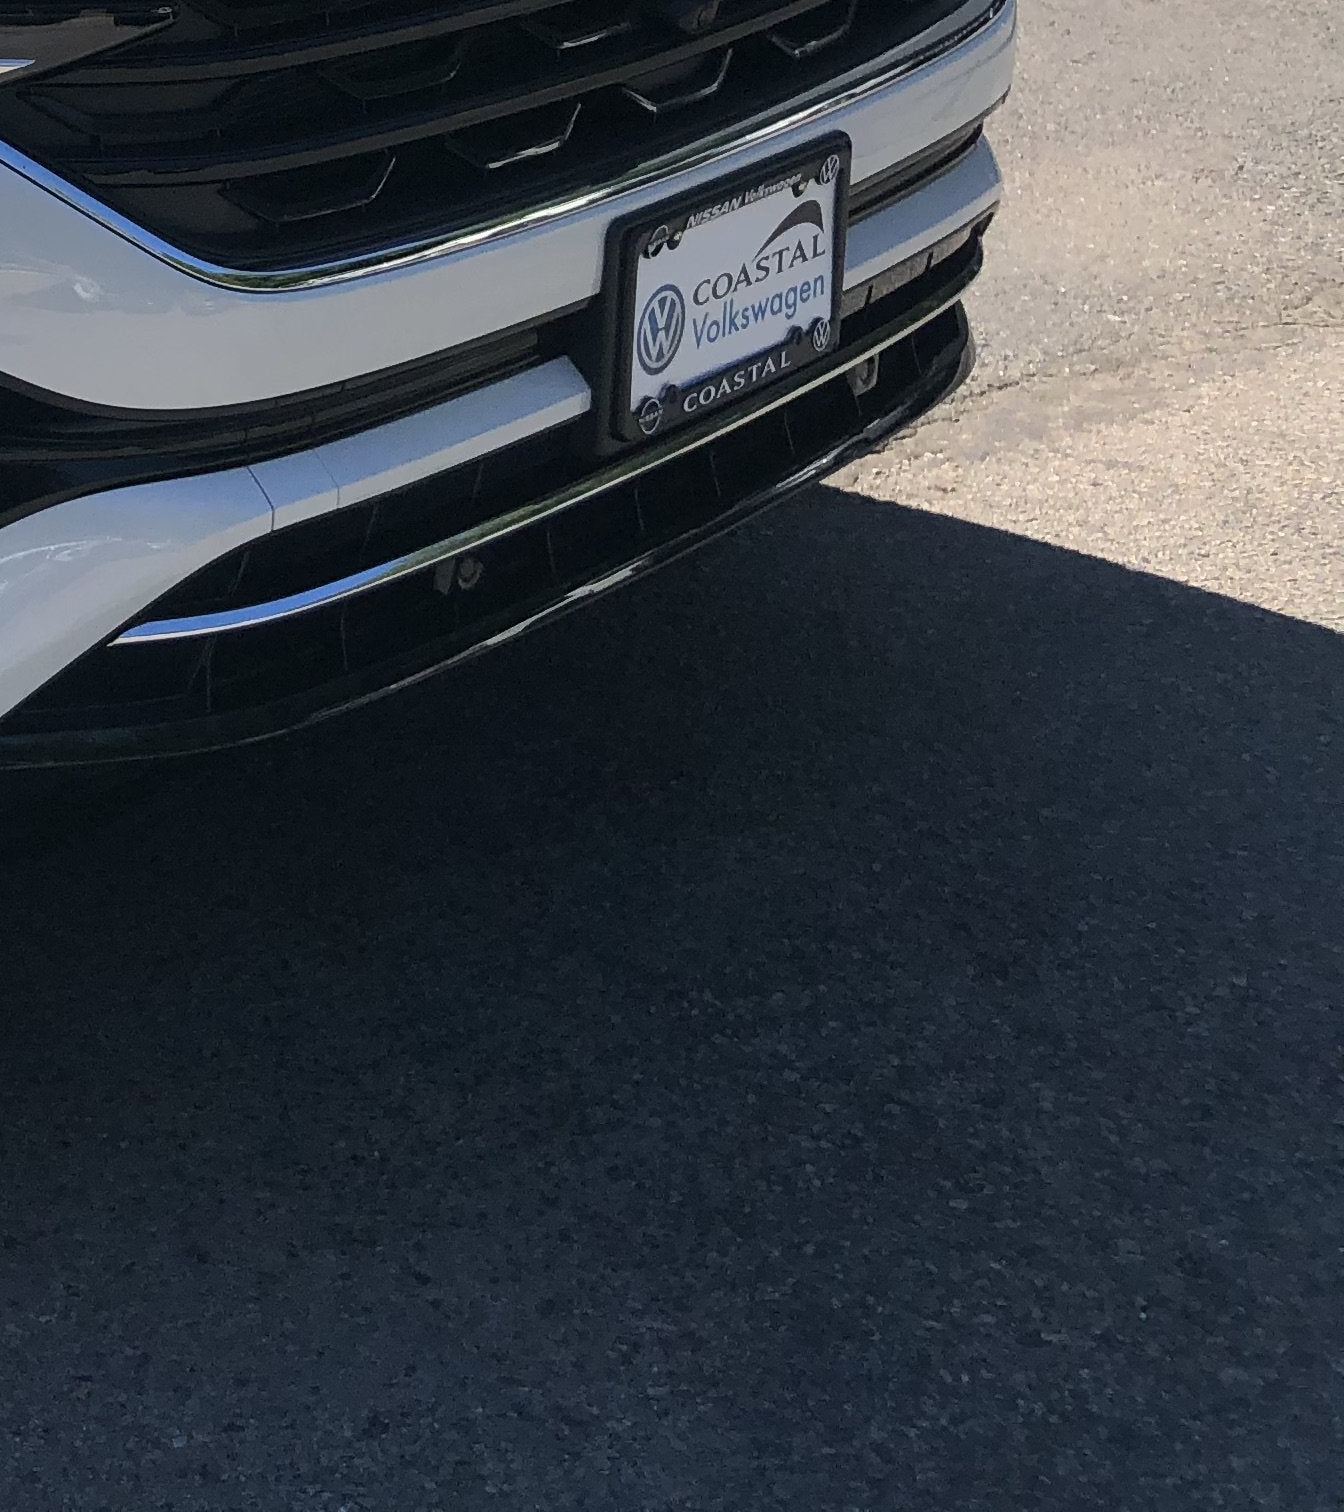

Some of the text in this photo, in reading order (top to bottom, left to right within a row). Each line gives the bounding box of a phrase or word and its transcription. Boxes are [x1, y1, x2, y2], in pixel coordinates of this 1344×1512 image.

[686, 194, 743, 229] NISSAN
[693, 233, 826, 306] COASTAL
[641, 290, 683, 369] VW
[693, 274, 825, 349] Volkswagen
[683, 351, 792, 413] COASTAL
